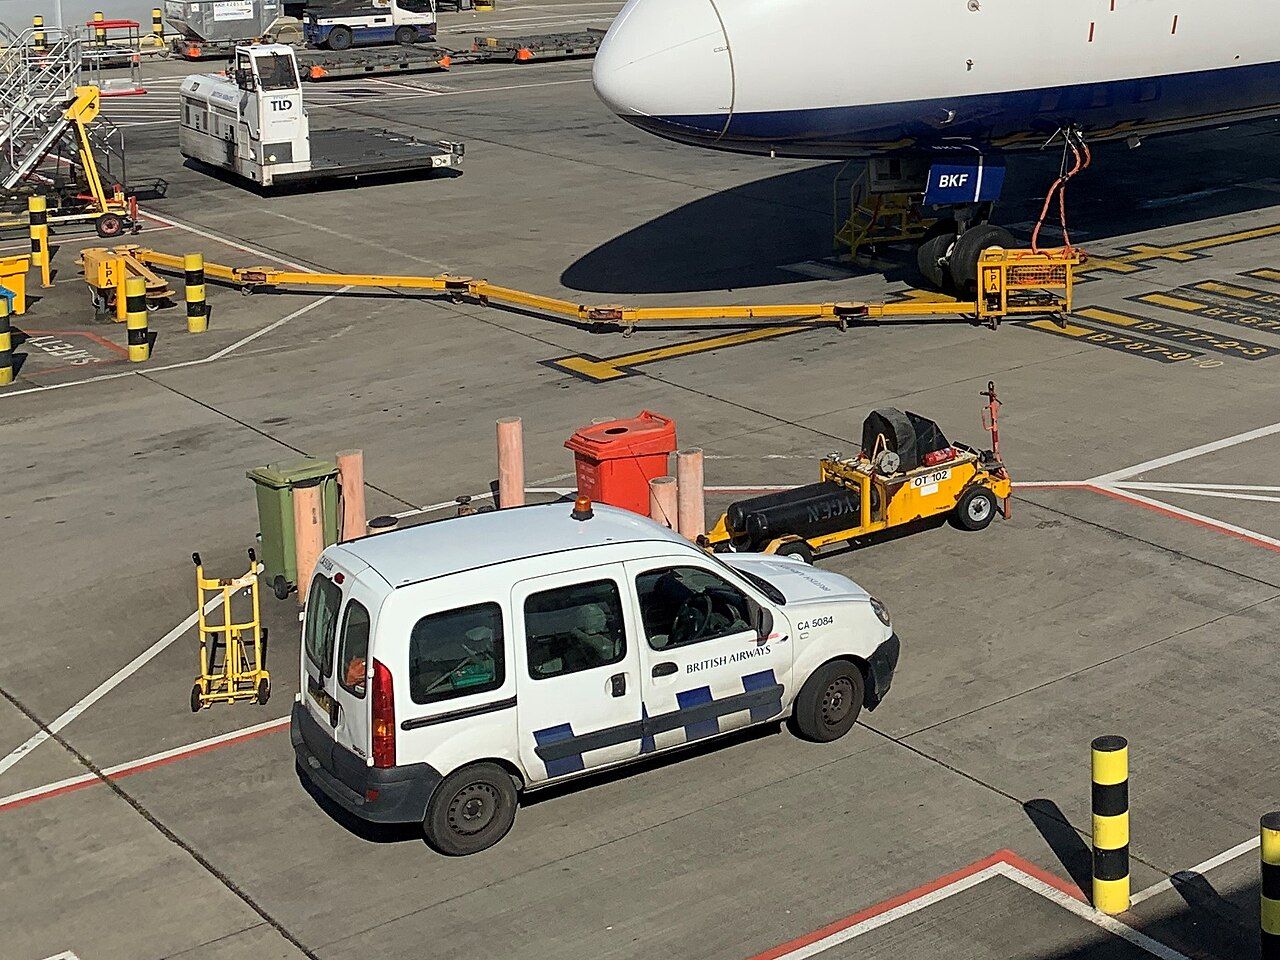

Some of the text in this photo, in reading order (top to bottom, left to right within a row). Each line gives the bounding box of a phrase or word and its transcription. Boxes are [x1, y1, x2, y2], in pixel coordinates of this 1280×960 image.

[271, 100, 293, 112] TLD
[939, 173, 969, 188] BKF
[105, 261, 113, 287] LPA
[914, 471, 948, 487] OT 102
[797, 616, 834, 631] CA 5084
[686, 645, 771, 674] BRITISH AIRWAYS
